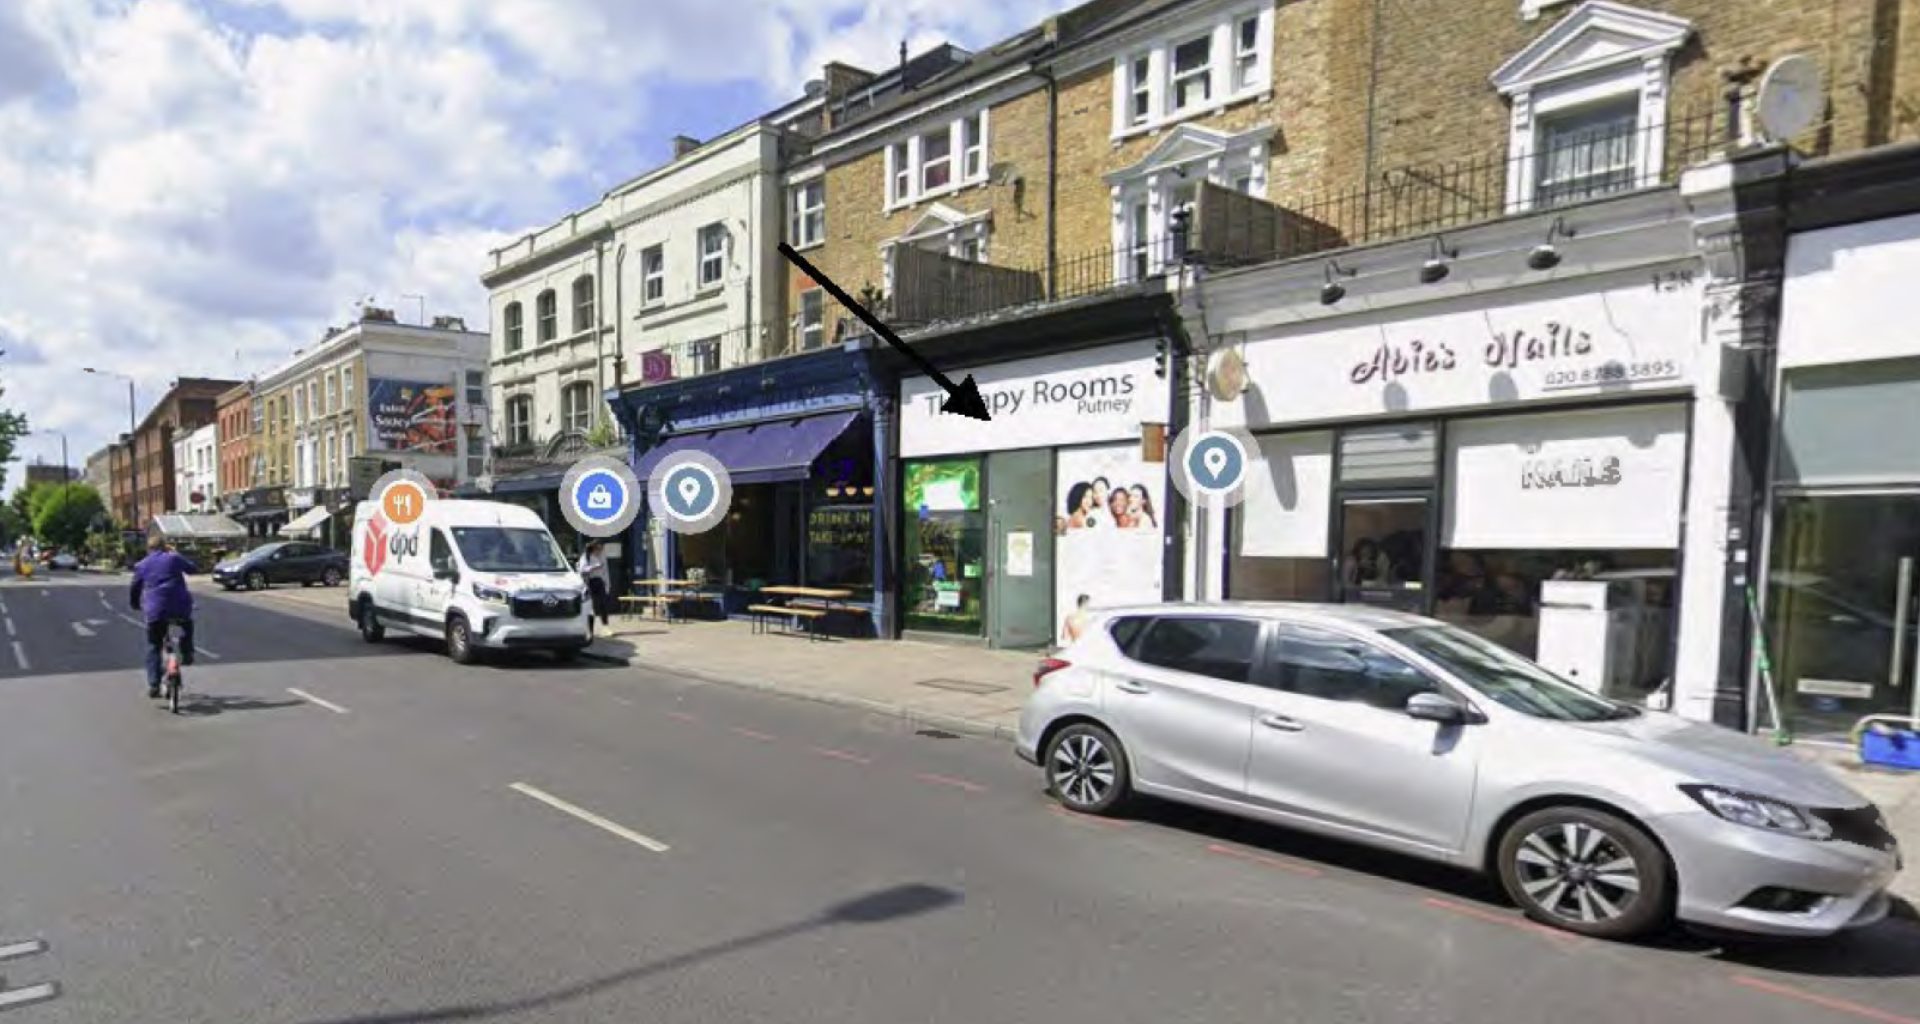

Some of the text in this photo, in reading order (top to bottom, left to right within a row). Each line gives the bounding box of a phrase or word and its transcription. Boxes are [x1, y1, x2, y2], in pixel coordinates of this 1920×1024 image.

[1486, 322, 1591, 368] Nails
[925, 374, 1134, 416] Tapy Rooms
[1077, 397, 1132, 415] Putney
[389, 527, 418, 563] dpd
